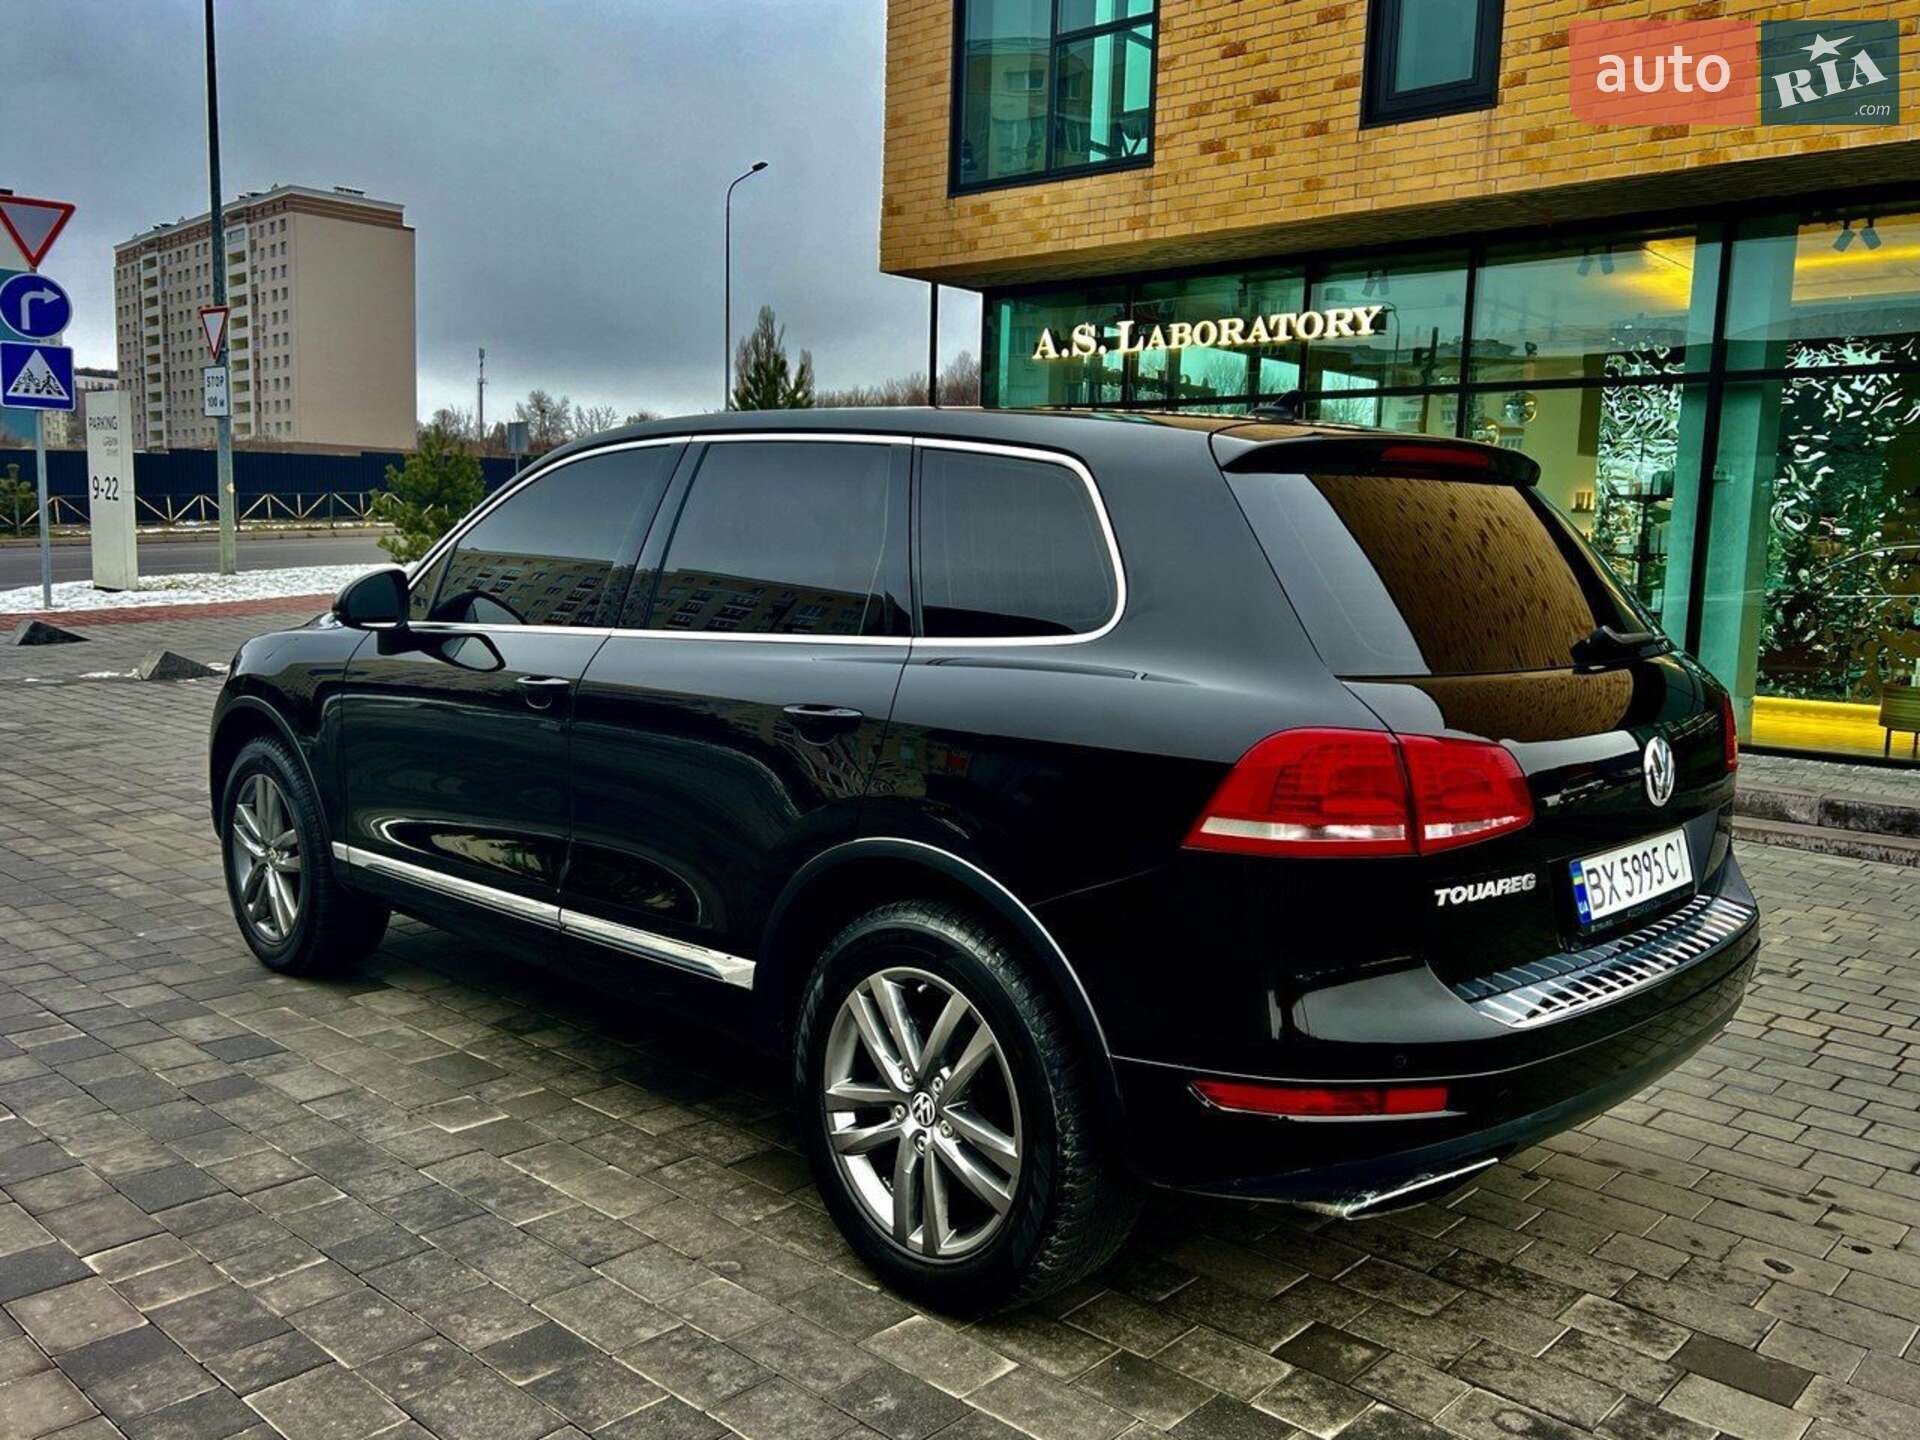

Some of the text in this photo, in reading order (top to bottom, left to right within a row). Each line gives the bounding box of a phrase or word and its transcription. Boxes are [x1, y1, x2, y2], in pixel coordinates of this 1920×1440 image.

[88, 415, 118, 431] PARKING
[92, 475, 119, 501] 9-22
[1433, 872, 1537, 907] TOUAREG
